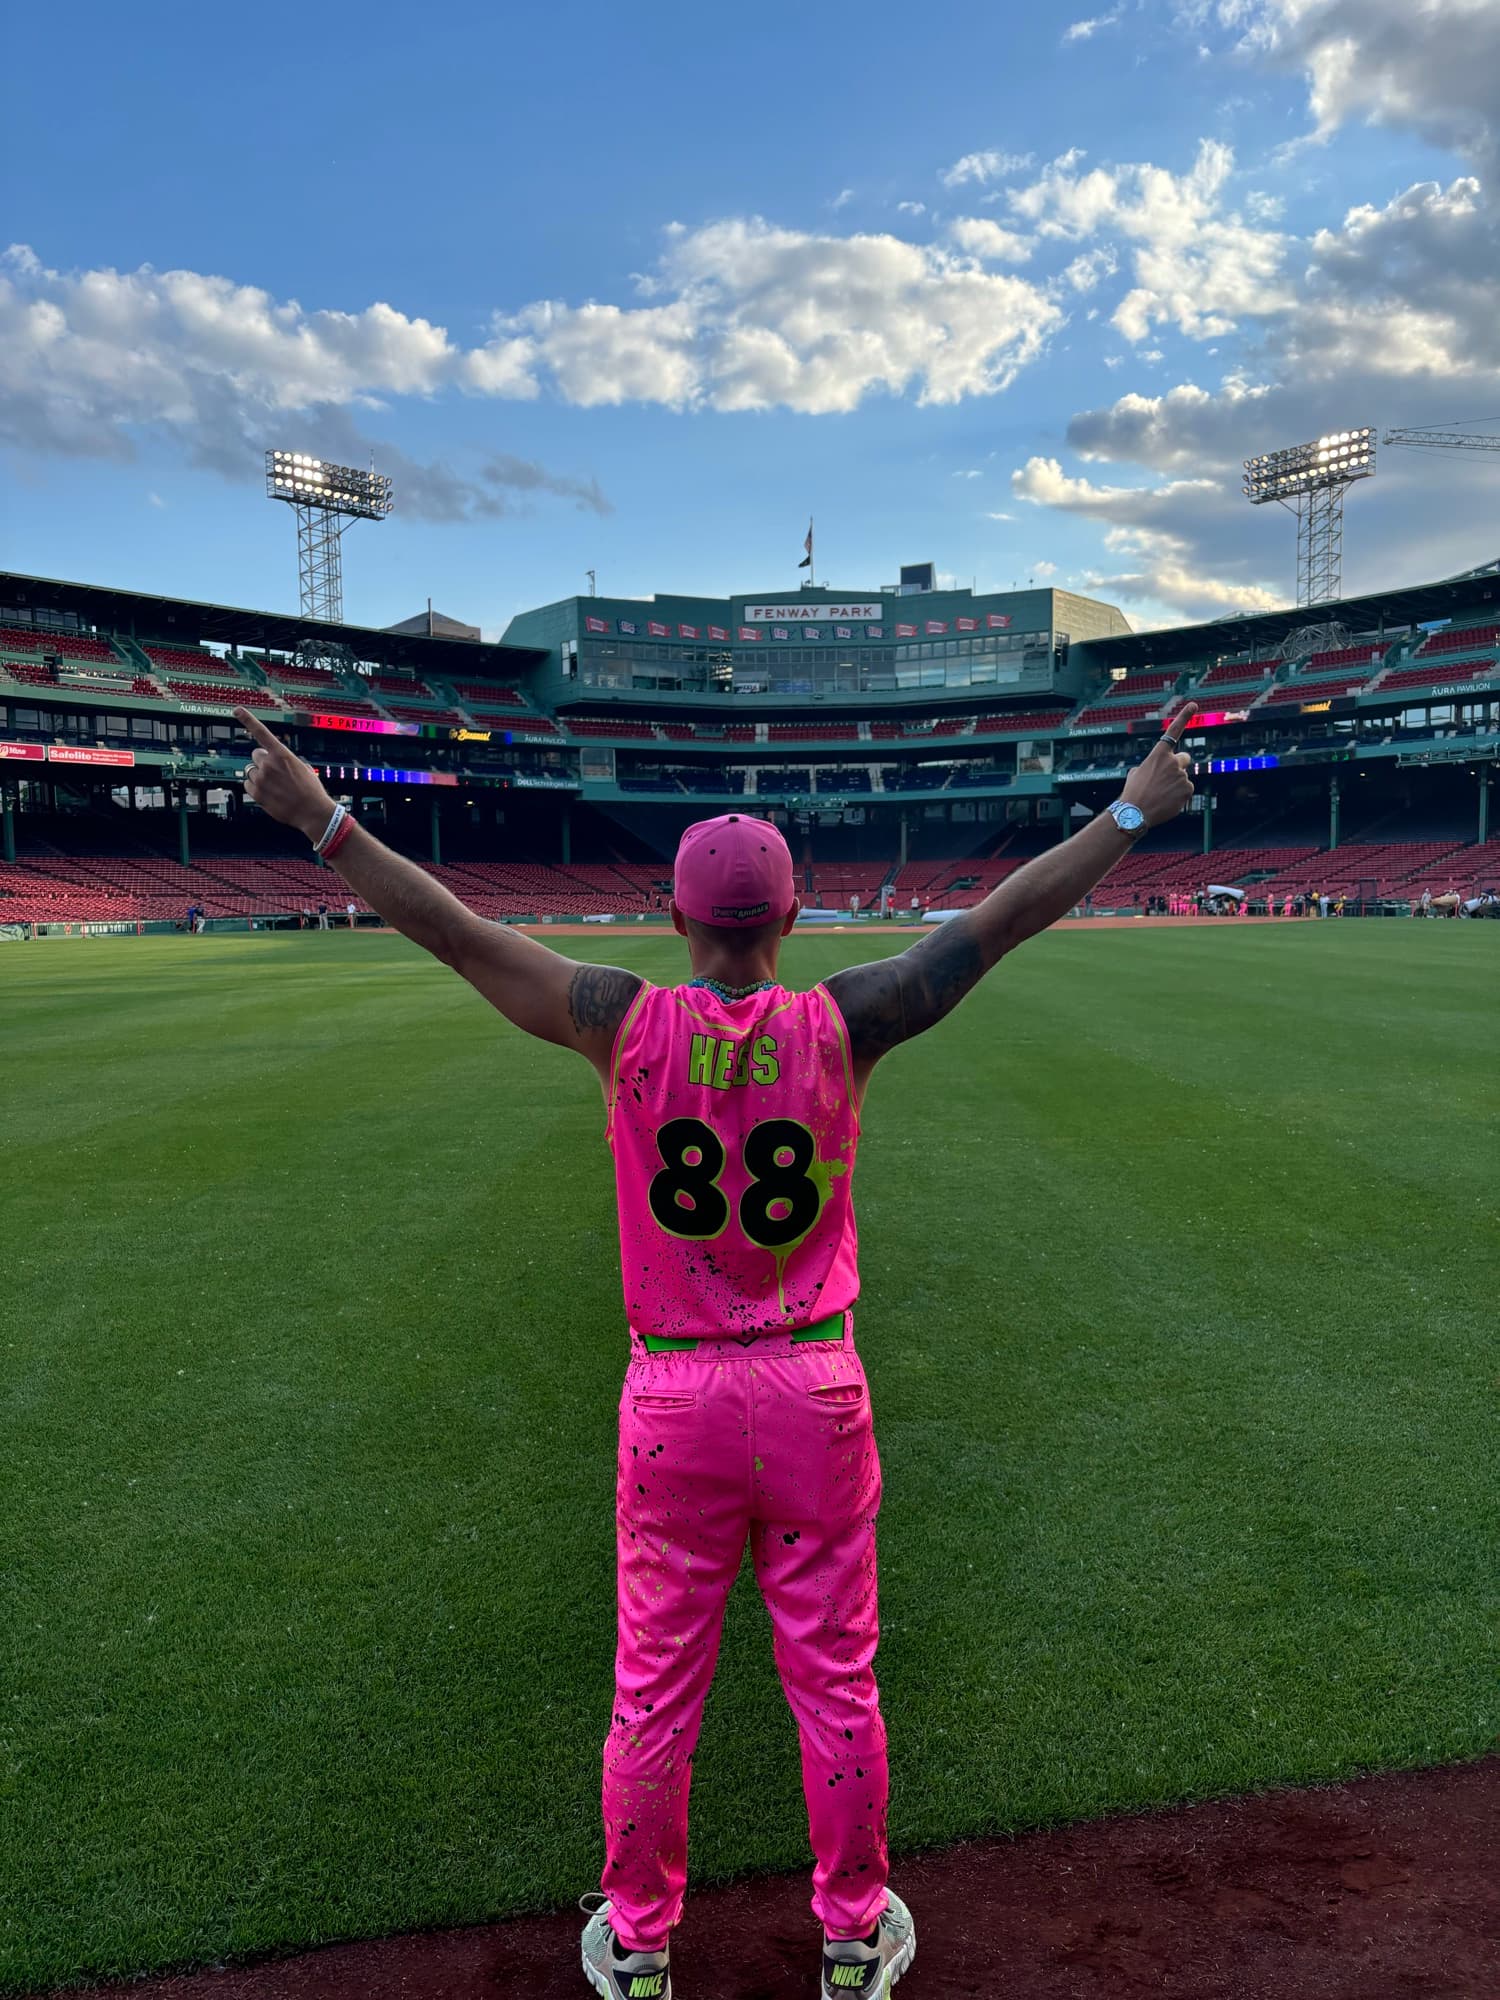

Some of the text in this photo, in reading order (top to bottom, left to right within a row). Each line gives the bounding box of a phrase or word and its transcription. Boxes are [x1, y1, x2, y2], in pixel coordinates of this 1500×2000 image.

[753, 606, 873, 619] FENWAY PARK
[1456, 682, 1491, 694] PAVILION
[50, 749, 92, 761] Safelite
[648, 1117, 822, 1249] 88
[629, 1972, 664, 1997] NIKE
[831, 1964, 867, 1987] NIKE
